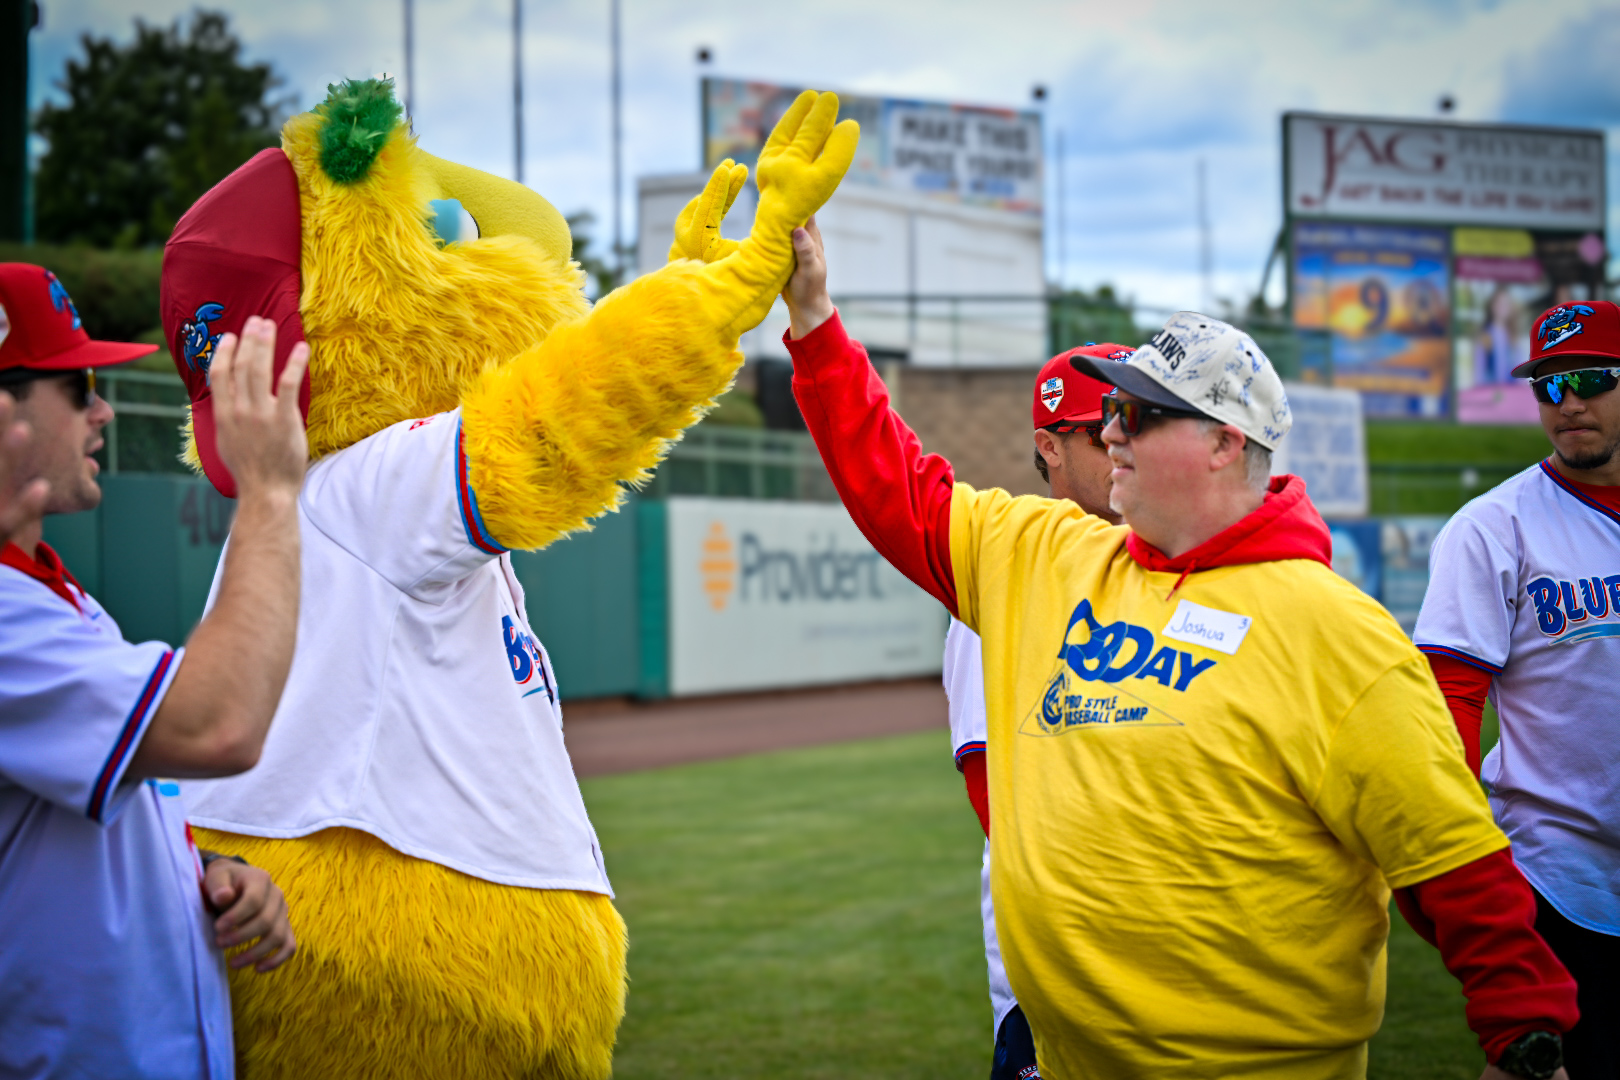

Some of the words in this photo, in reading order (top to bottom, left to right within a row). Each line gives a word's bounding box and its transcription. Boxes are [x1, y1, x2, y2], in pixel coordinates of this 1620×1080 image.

[902, 113, 966, 147] MAKE
[976, 121, 1028, 152] THIS
[1456, 133, 1594, 161] PHYSICAL
[1300, 122, 1448, 207] JAG
[1460, 161, 1592, 189] THERAPY
[1149, 329, 1186, 371] LAWS
[740, 531, 886, 603] Provident
[1526, 574, 1620, 637] BLUE
[1170, 610, 1225, 642] Joshua
[1084, 695, 1119, 711] STYLE
[1114, 706, 1149, 723] CAMP
